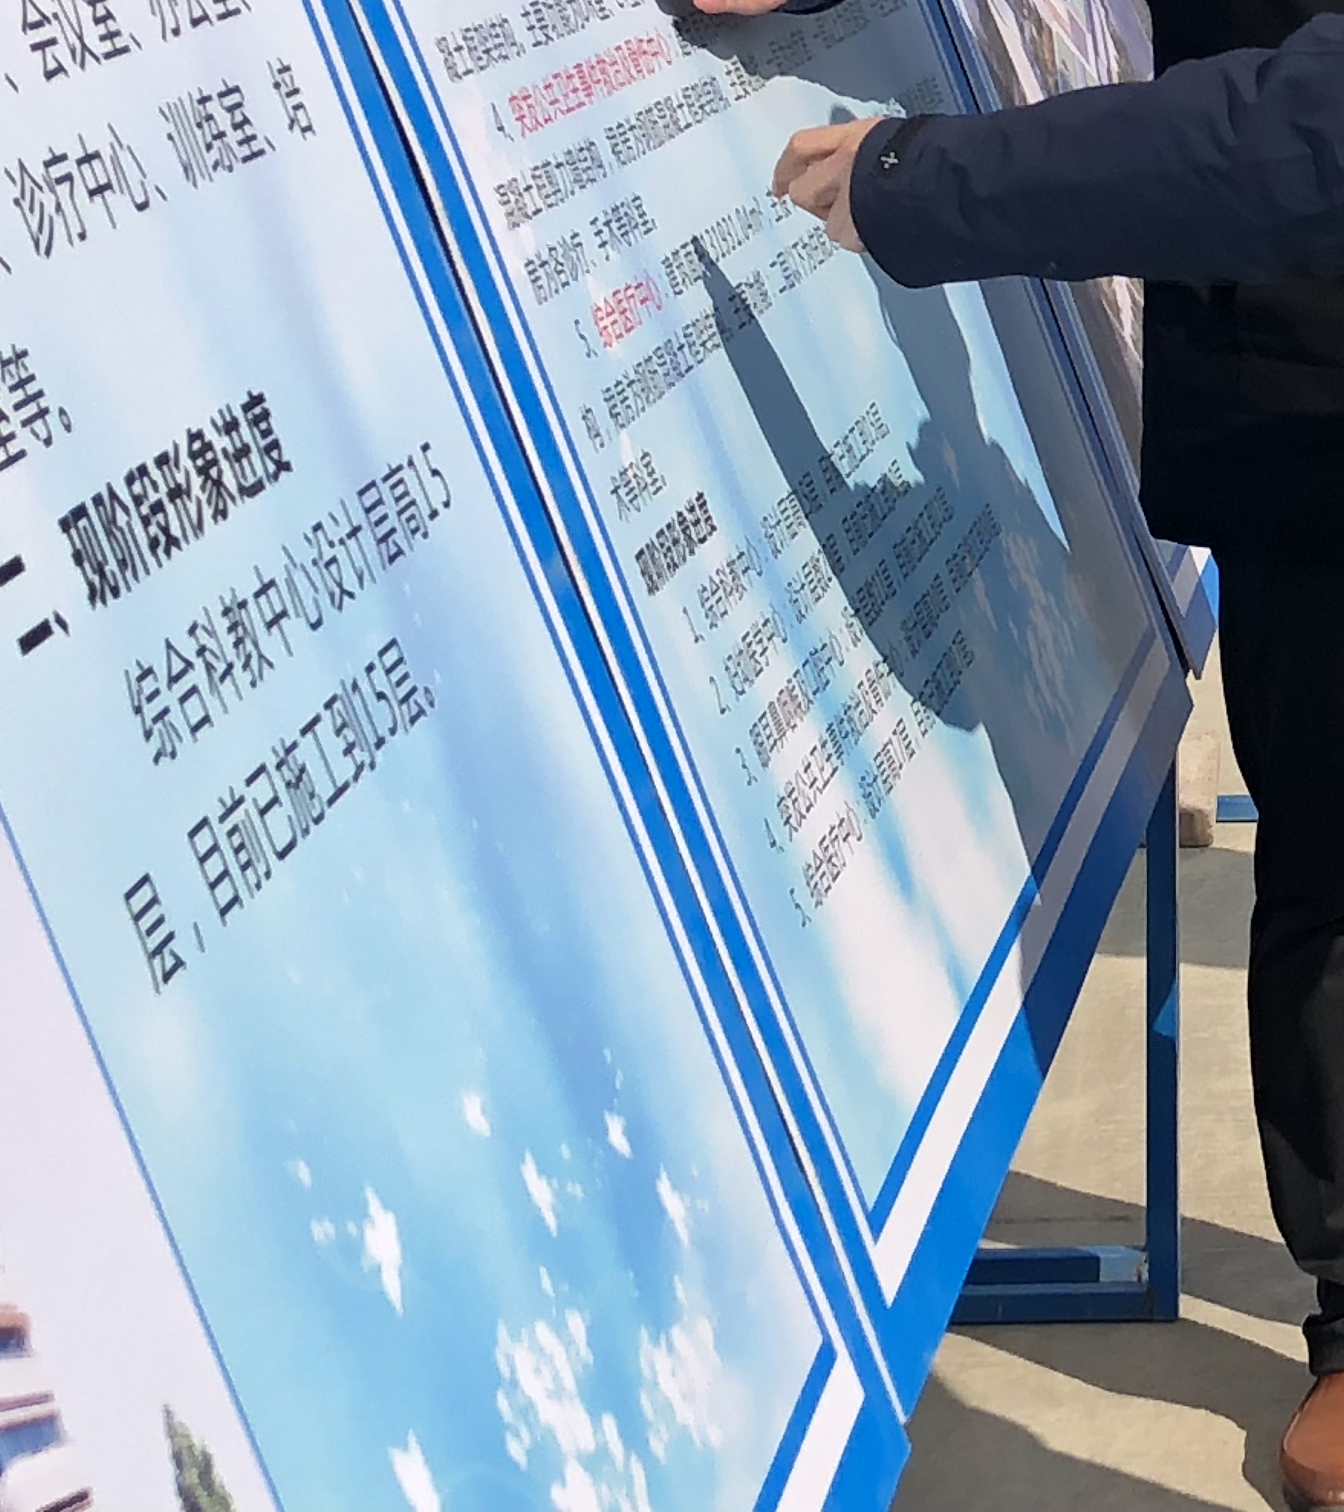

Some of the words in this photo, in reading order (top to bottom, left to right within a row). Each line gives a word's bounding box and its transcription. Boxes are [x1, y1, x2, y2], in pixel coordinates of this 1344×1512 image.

[124, 440, 453, 766] 综合科教中心设计层高15
[632, 487, 718, 599] 现阶段形象进度
